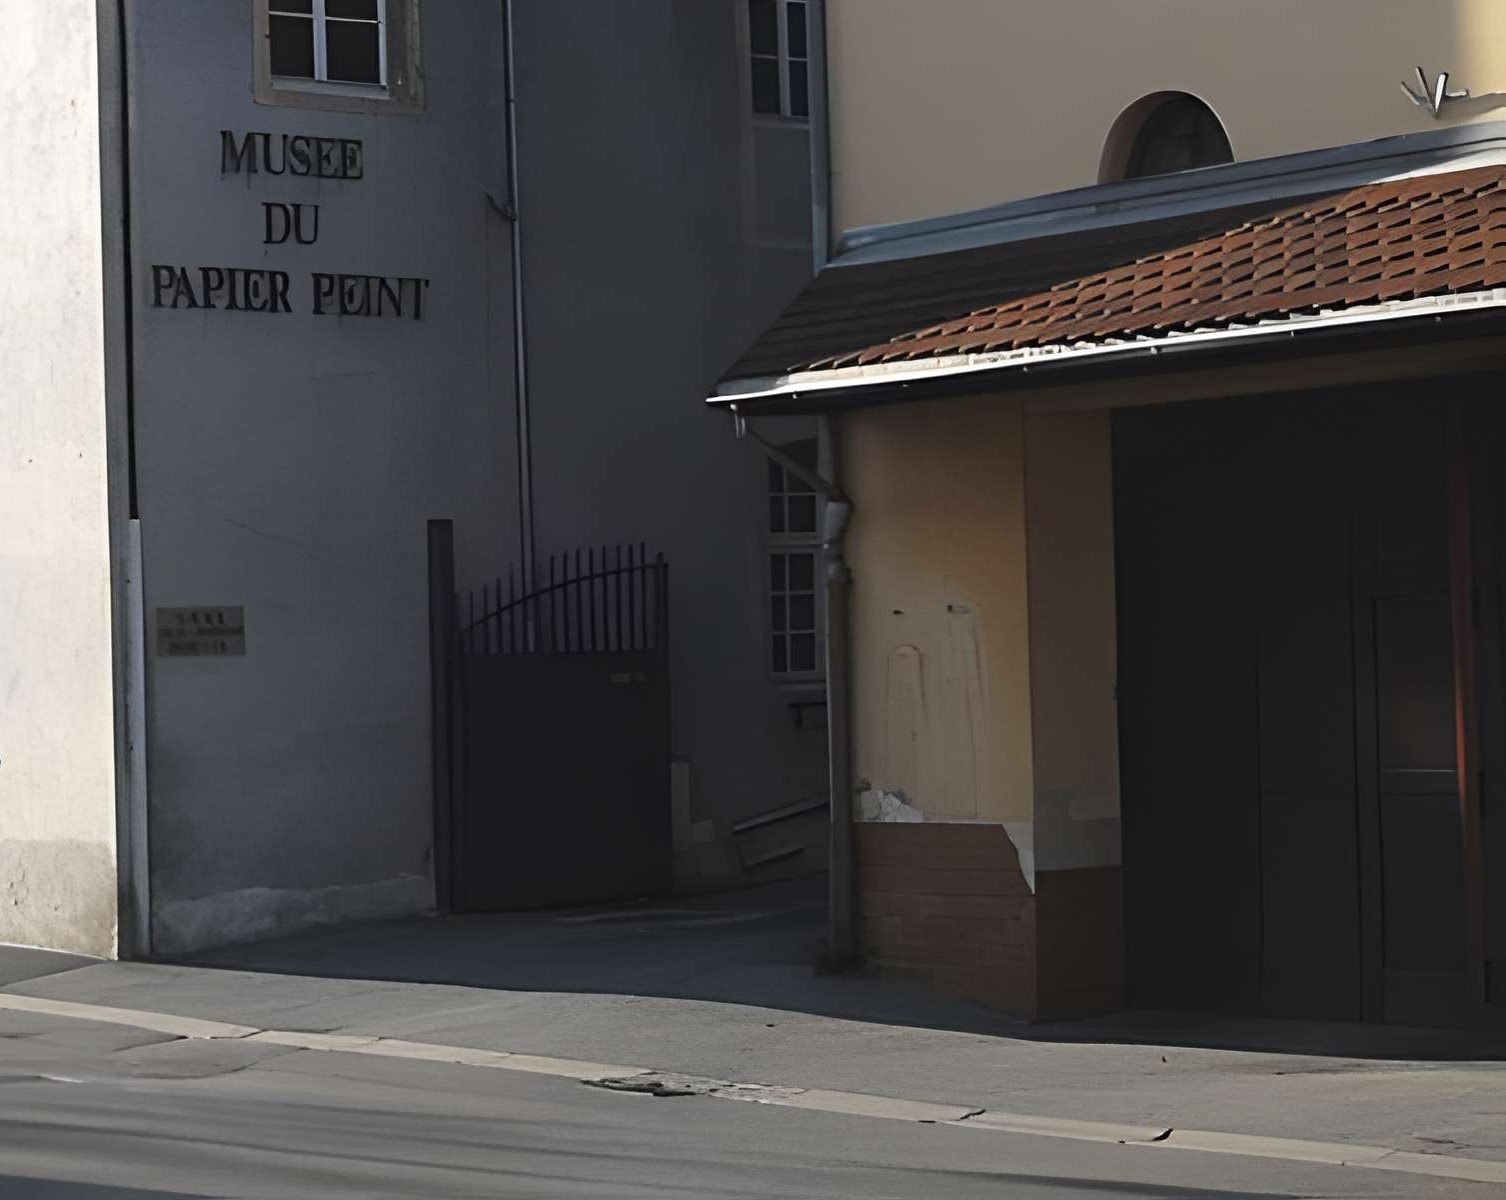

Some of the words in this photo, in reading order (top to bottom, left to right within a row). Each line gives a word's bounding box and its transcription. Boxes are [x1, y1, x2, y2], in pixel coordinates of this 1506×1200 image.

[220, 130, 363, 179] MUSEE
[262, 202, 319, 245] DU
[151, 265, 292, 313] PAPIER
[311, 273, 430, 320] PEINT
